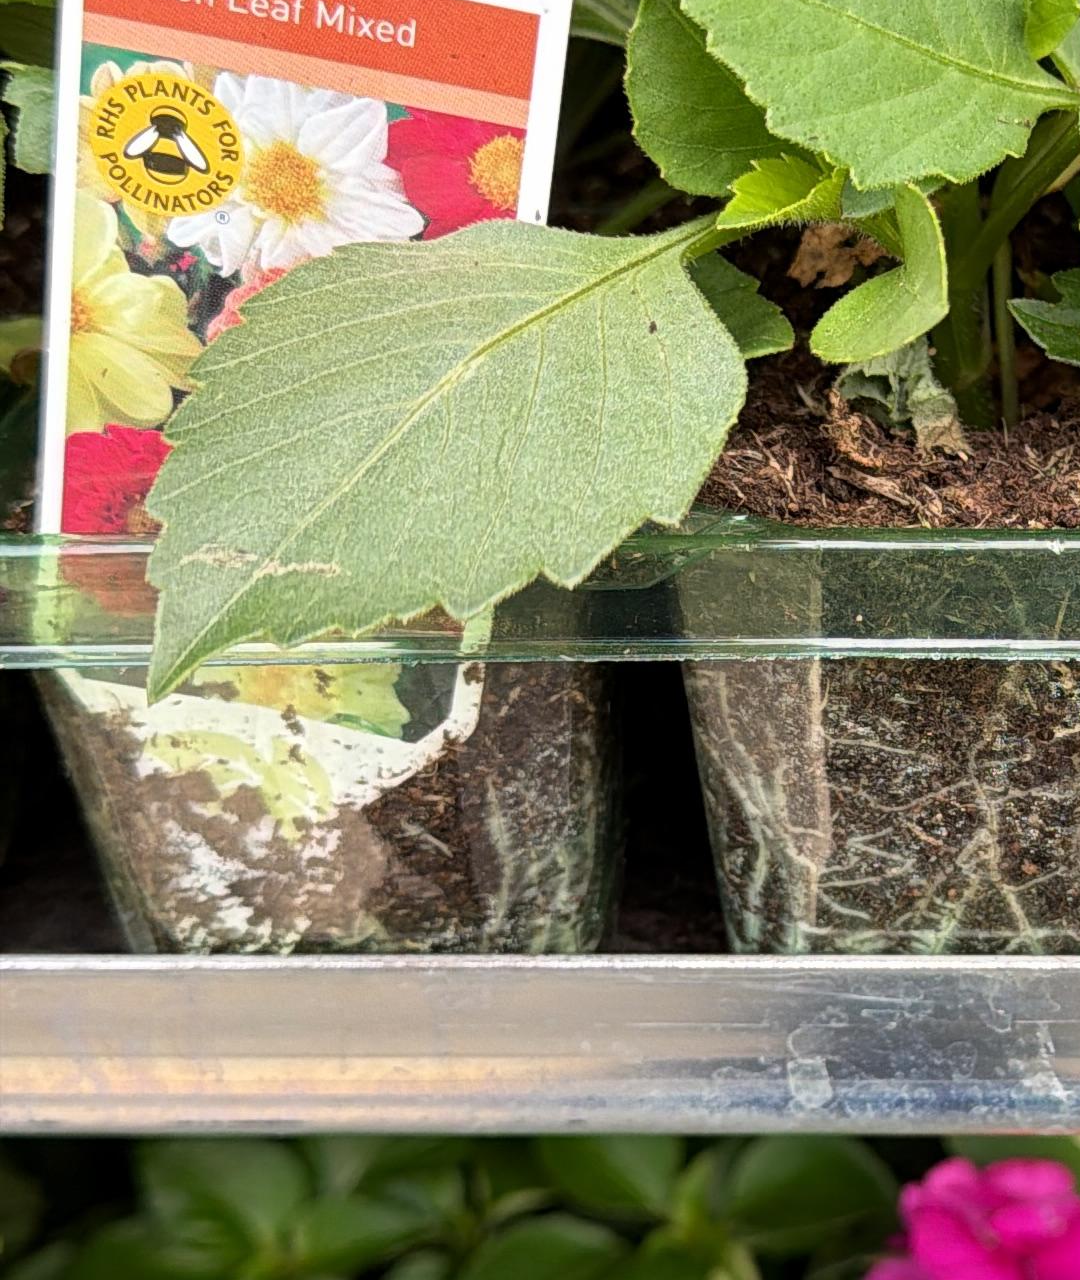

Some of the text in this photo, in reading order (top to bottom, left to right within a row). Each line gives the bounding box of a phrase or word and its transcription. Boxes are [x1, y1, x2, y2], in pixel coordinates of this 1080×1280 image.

[315, 0, 417, 48] Mixed
[96, 79, 240, 162] RHS PLANTS FOR
[100, 151, 234, 212] POLLINATORS
